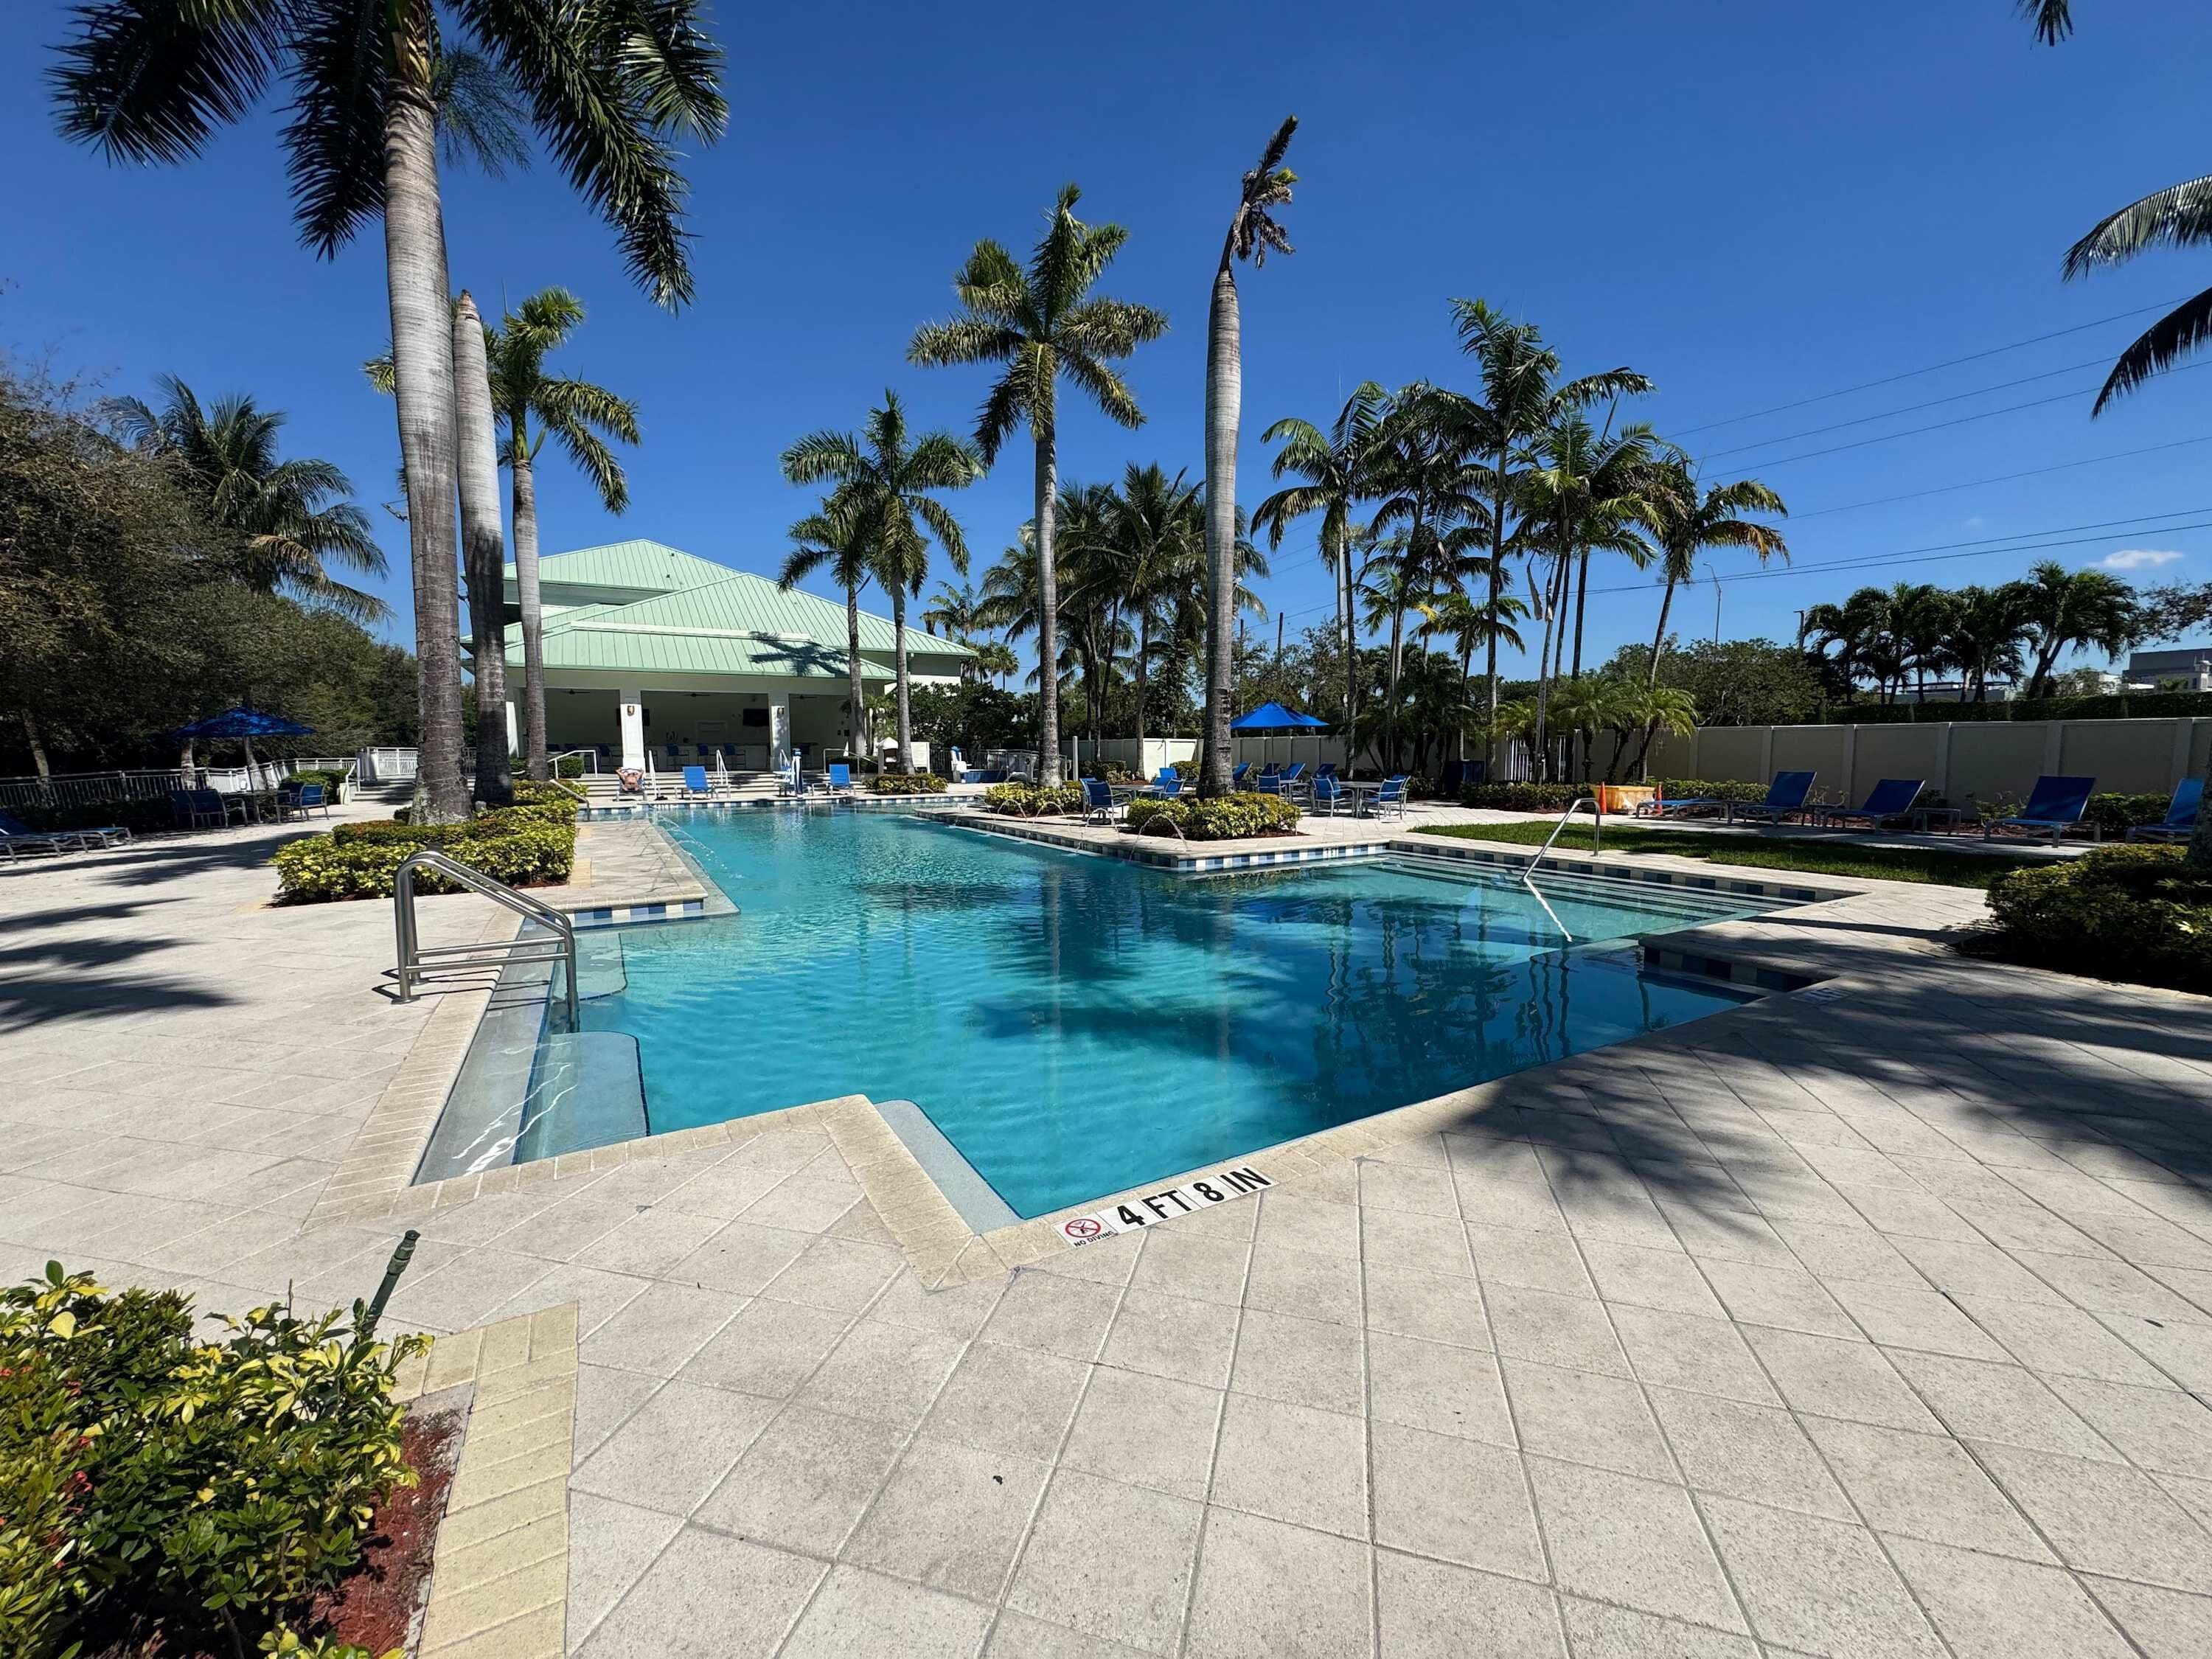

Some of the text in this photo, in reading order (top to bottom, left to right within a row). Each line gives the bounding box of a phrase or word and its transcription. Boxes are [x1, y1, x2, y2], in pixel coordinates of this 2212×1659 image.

[1117, 1167, 1271, 1225] 4 FT 8 IN
[1074, 1230, 1115, 1248] NO DIVING
